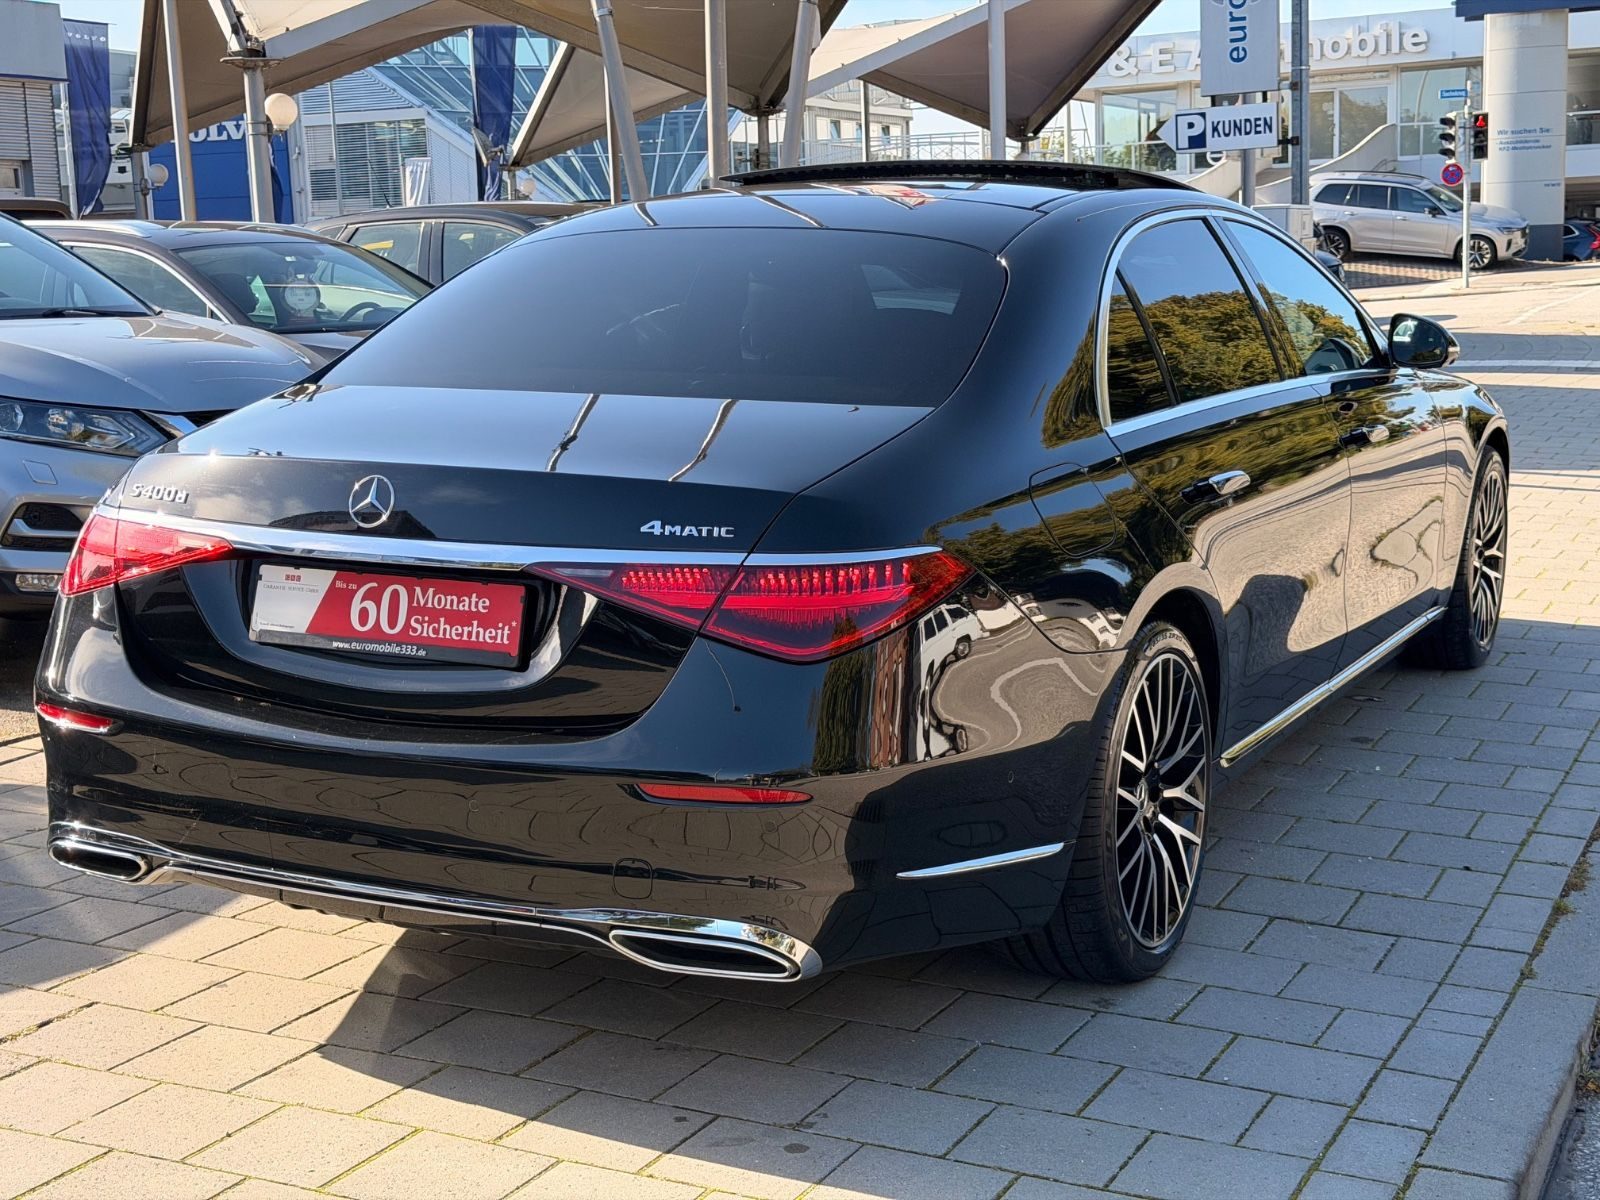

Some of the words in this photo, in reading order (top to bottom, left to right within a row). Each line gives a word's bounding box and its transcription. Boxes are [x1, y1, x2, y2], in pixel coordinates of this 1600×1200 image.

[1107, 45, 1139, 77] &
[1152, 42, 1176, 74] E
[1177, 114, 1205, 149] P
[1211, 116, 1273, 138] KUNDEN
[640, 520, 735, 538] 4MATIC
[335, 580, 347, 590] Bis
[350, 582, 408, 635] 60
[411, 586, 490, 613] Monate
[332, 641, 427, 657] www.euromobile333.de
